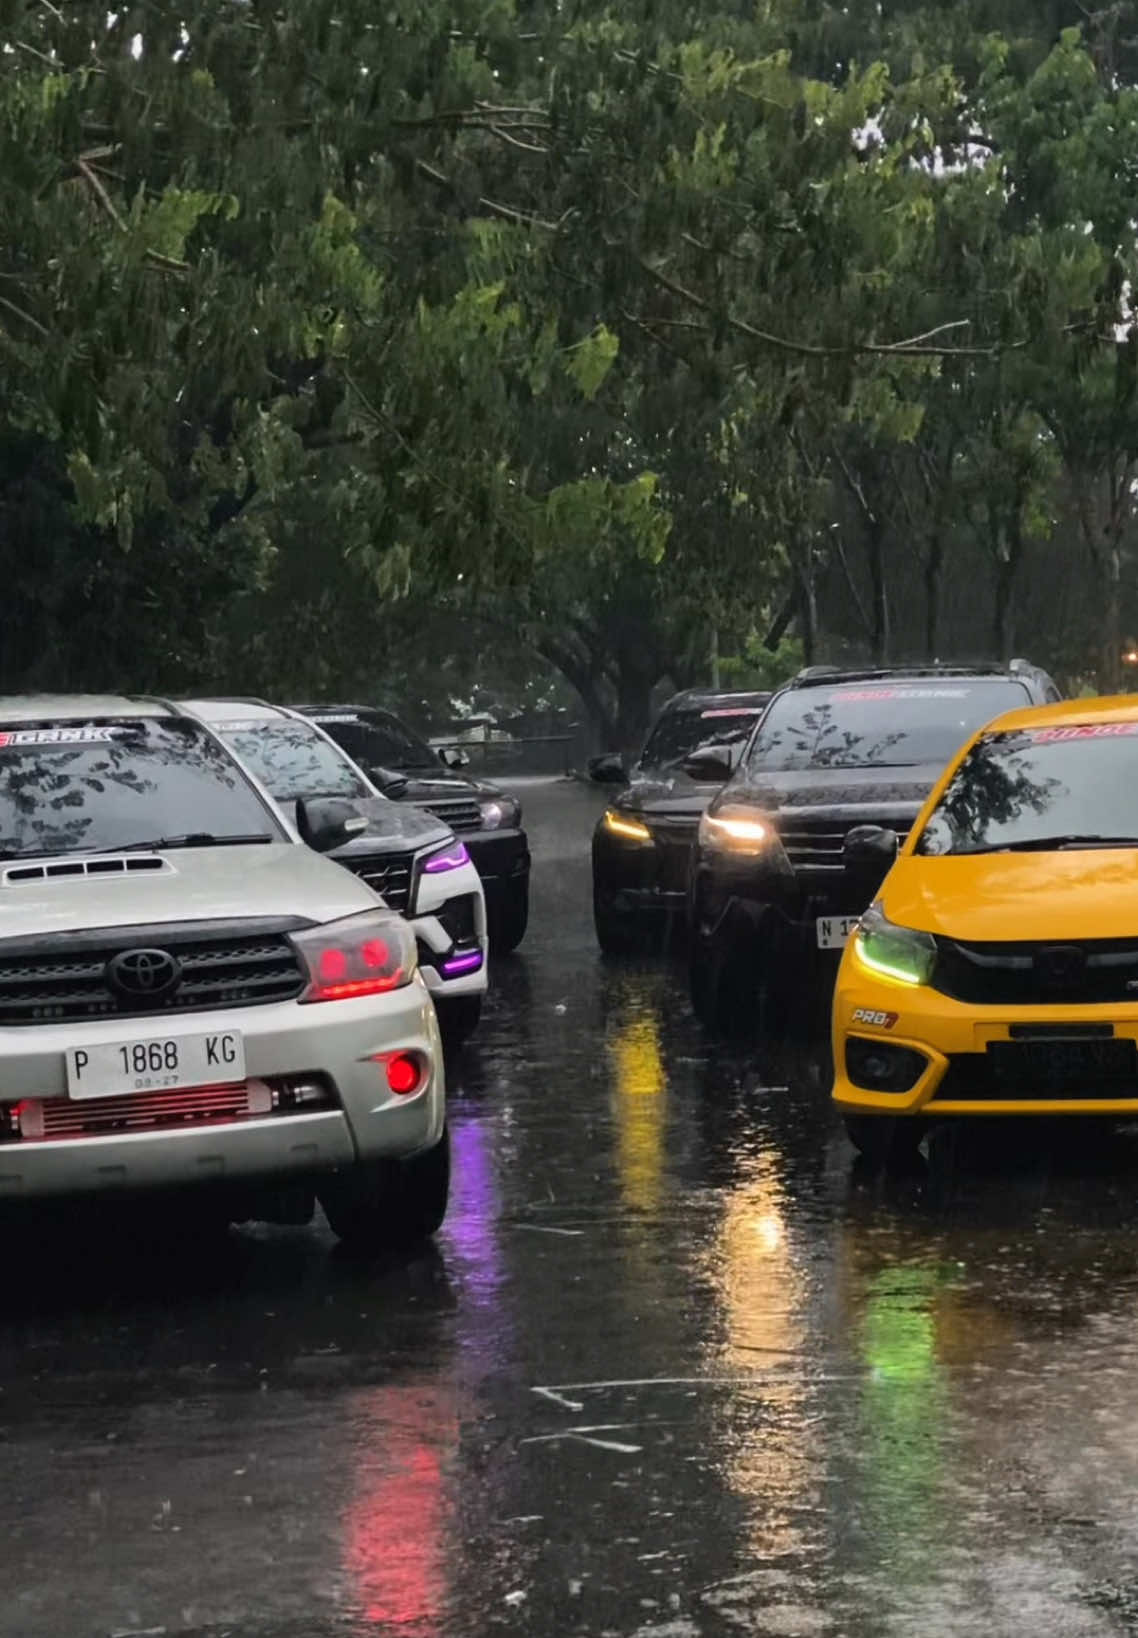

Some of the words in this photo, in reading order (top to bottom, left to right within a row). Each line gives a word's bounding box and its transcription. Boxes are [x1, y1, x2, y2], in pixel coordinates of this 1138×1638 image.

[822, 919, 832, 937] N
[74, 1050, 89, 1080] P
[119, 1041, 179, 1075] 1868
[205, 1035, 236, 1066] KG
